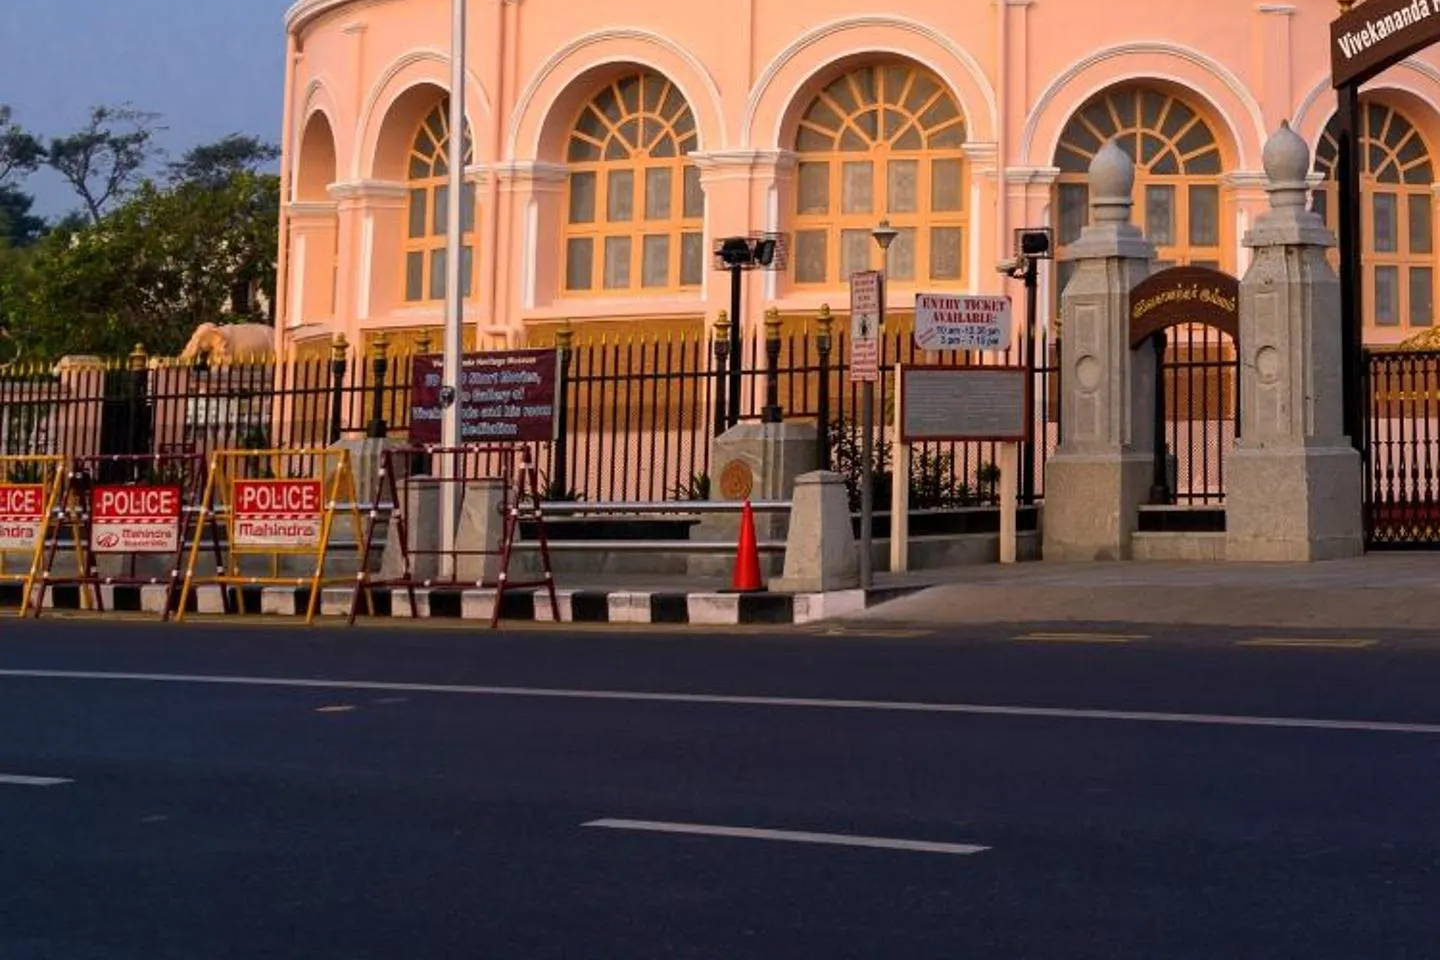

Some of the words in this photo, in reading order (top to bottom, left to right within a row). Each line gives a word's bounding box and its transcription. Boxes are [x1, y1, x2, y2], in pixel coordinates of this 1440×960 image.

[922, 297, 960, 310] ENTRY
[964, 299, 1005, 311] TICKET
[102, 491, 173, 515] POLICE
[243, 486, 315, 510] POLICE
[239, 523, 315, 537] Mahindra
